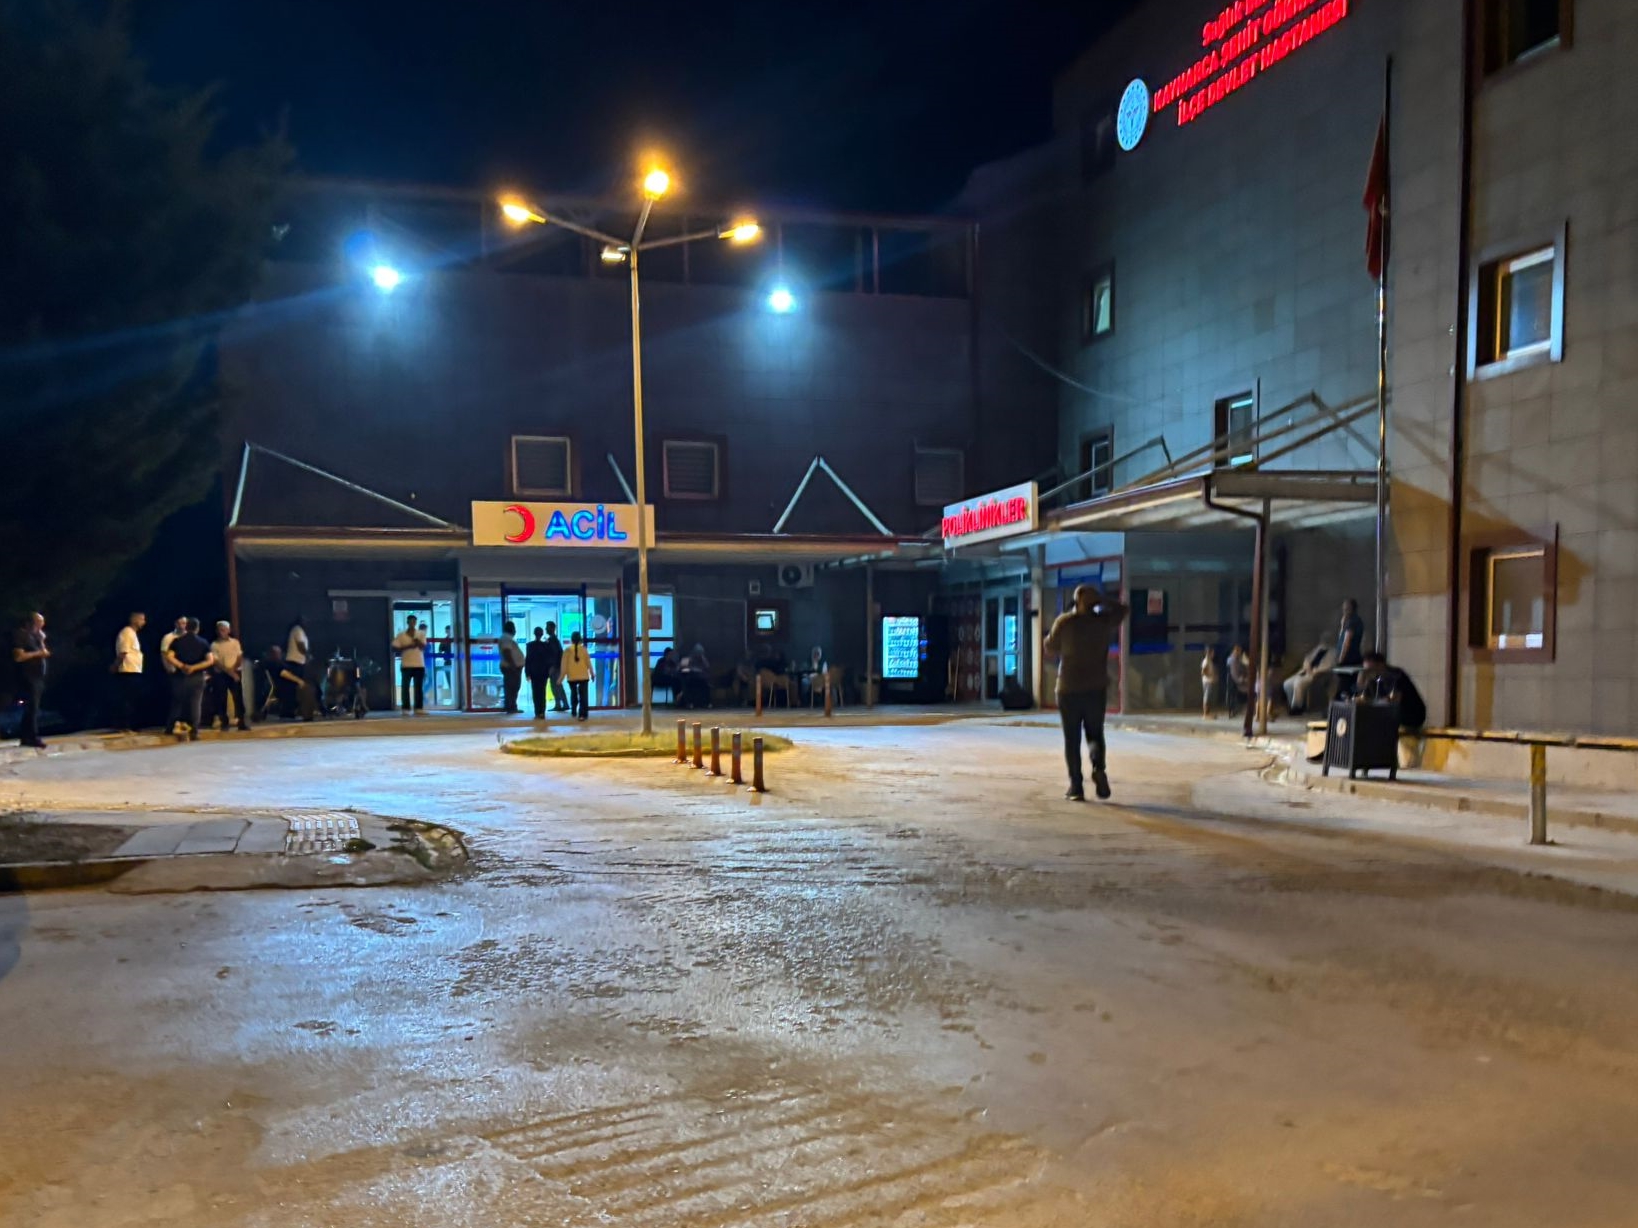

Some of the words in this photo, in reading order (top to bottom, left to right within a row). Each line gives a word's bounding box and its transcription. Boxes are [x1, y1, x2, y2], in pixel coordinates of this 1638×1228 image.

[1207, 52, 1258, 107] DEVLET
[545, 503, 628, 540] ACİL
[941, 496, 1026, 539] POLİKLİNİKLER
